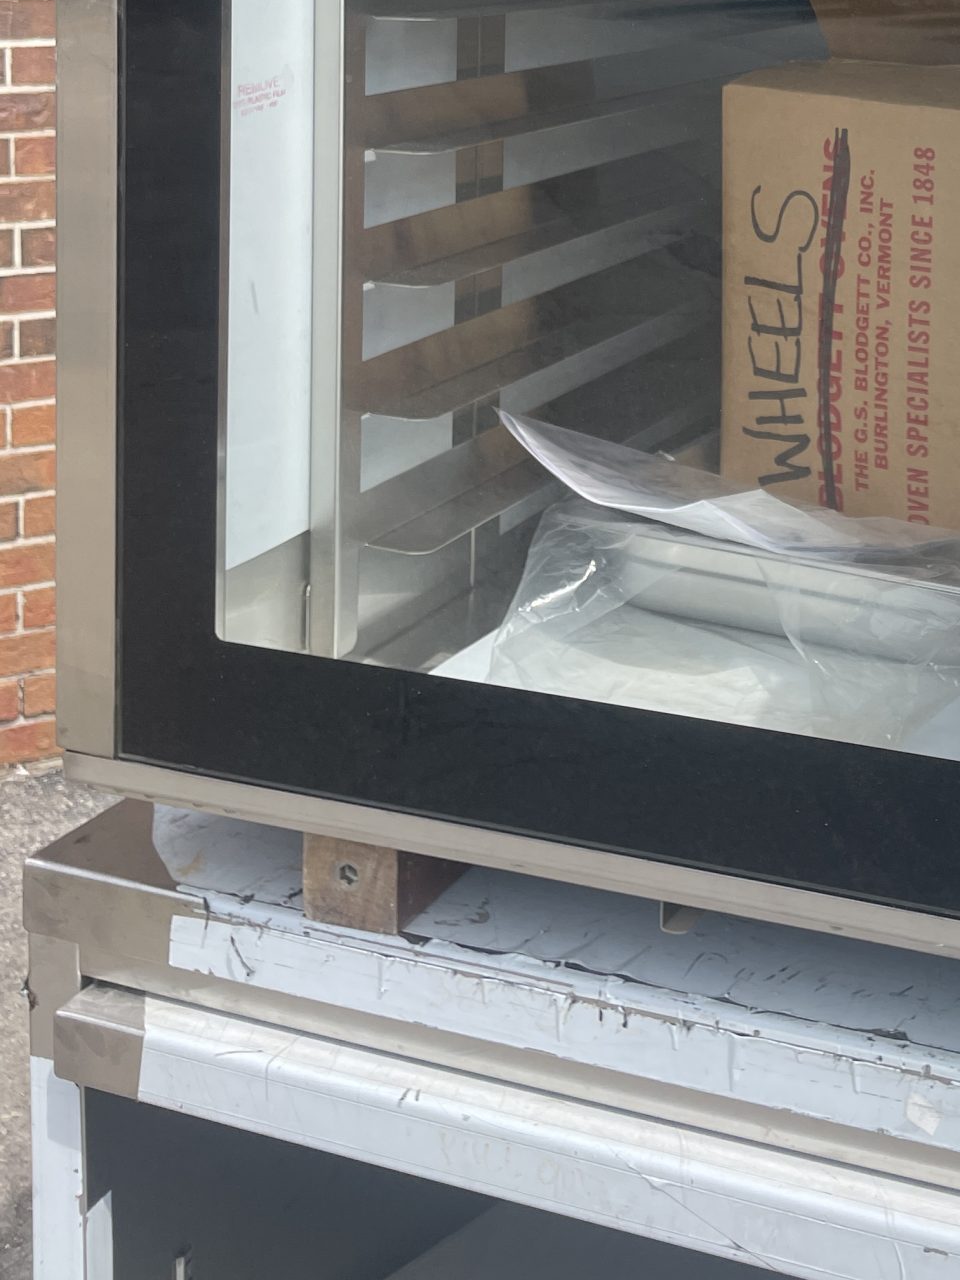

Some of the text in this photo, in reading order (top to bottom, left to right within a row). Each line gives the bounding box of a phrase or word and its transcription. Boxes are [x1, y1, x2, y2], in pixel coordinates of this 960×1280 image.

[909, 214, 934, 289] SINCE
[912, 146, 936, 206] 1848
[742, 184, 819, 486] WHEELS
[854, 169, 876, 492] THE G.S. BLODGETT CO., INC.
[874, 198, 895, 470] BURLINGTON, VERMONT
[906, 299, 931, 458] SPECIALISTS
